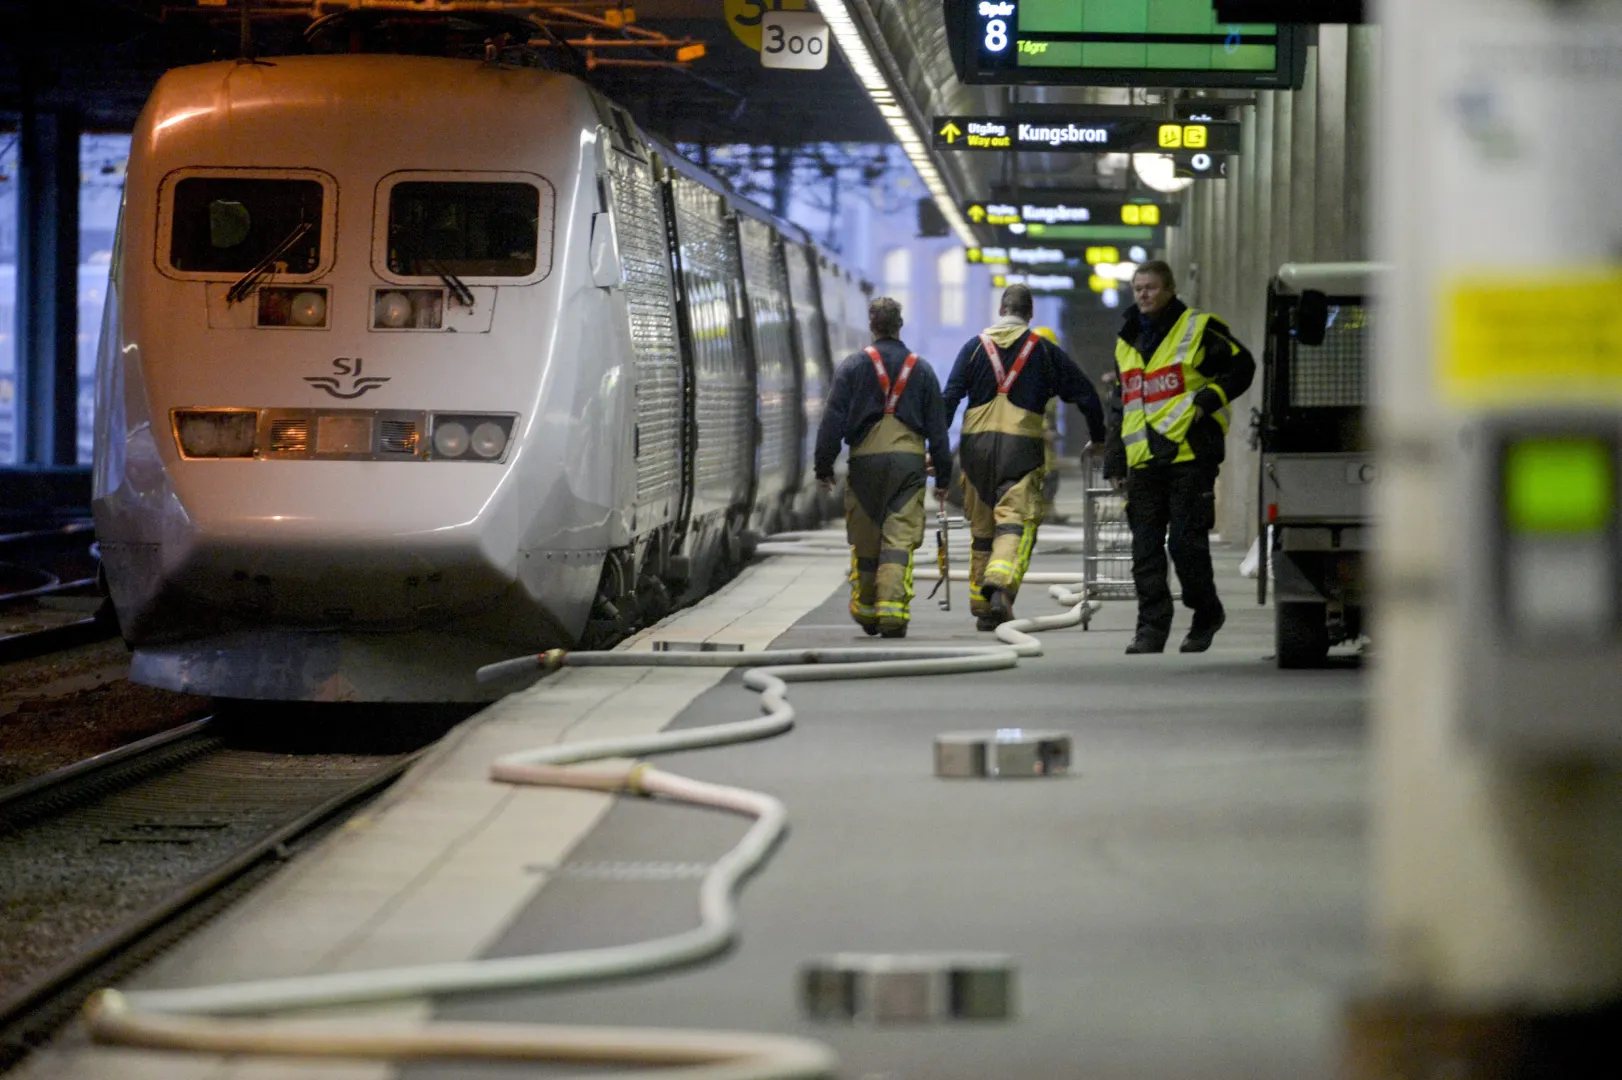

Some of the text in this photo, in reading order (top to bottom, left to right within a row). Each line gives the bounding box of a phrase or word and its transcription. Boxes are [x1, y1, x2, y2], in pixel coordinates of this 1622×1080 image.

[765, 24, 823, 55] 300
[984, 19, 1008, 52] 8
[968, 122, 1007, 137] Utgång
[1018, 124, 1108, 146] Kungsbron
[967, 135, 1011, 147] Way out
[333, 357, 363, 377] SJ
